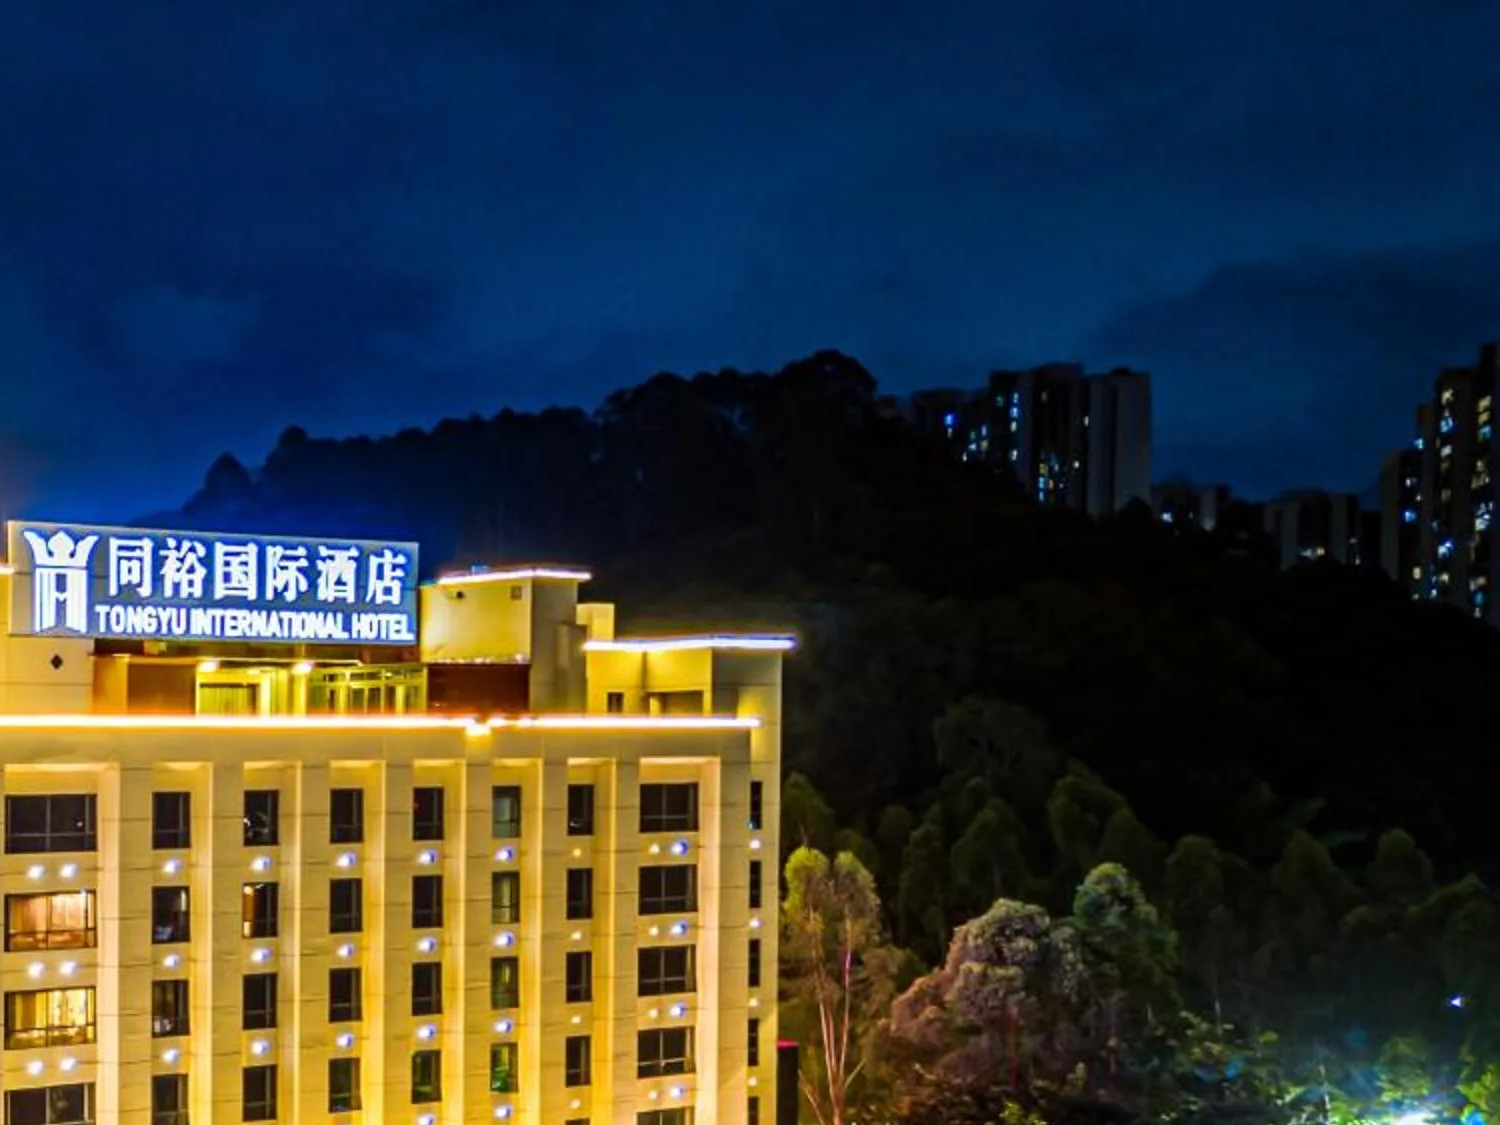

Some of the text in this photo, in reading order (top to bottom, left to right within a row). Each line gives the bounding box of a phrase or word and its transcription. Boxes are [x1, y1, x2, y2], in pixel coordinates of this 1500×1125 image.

[108, 536, 407, 605] 同裕国际酒店
[95, 605, 415, 641] TONGYU INTERNATIONAL HOTEL
